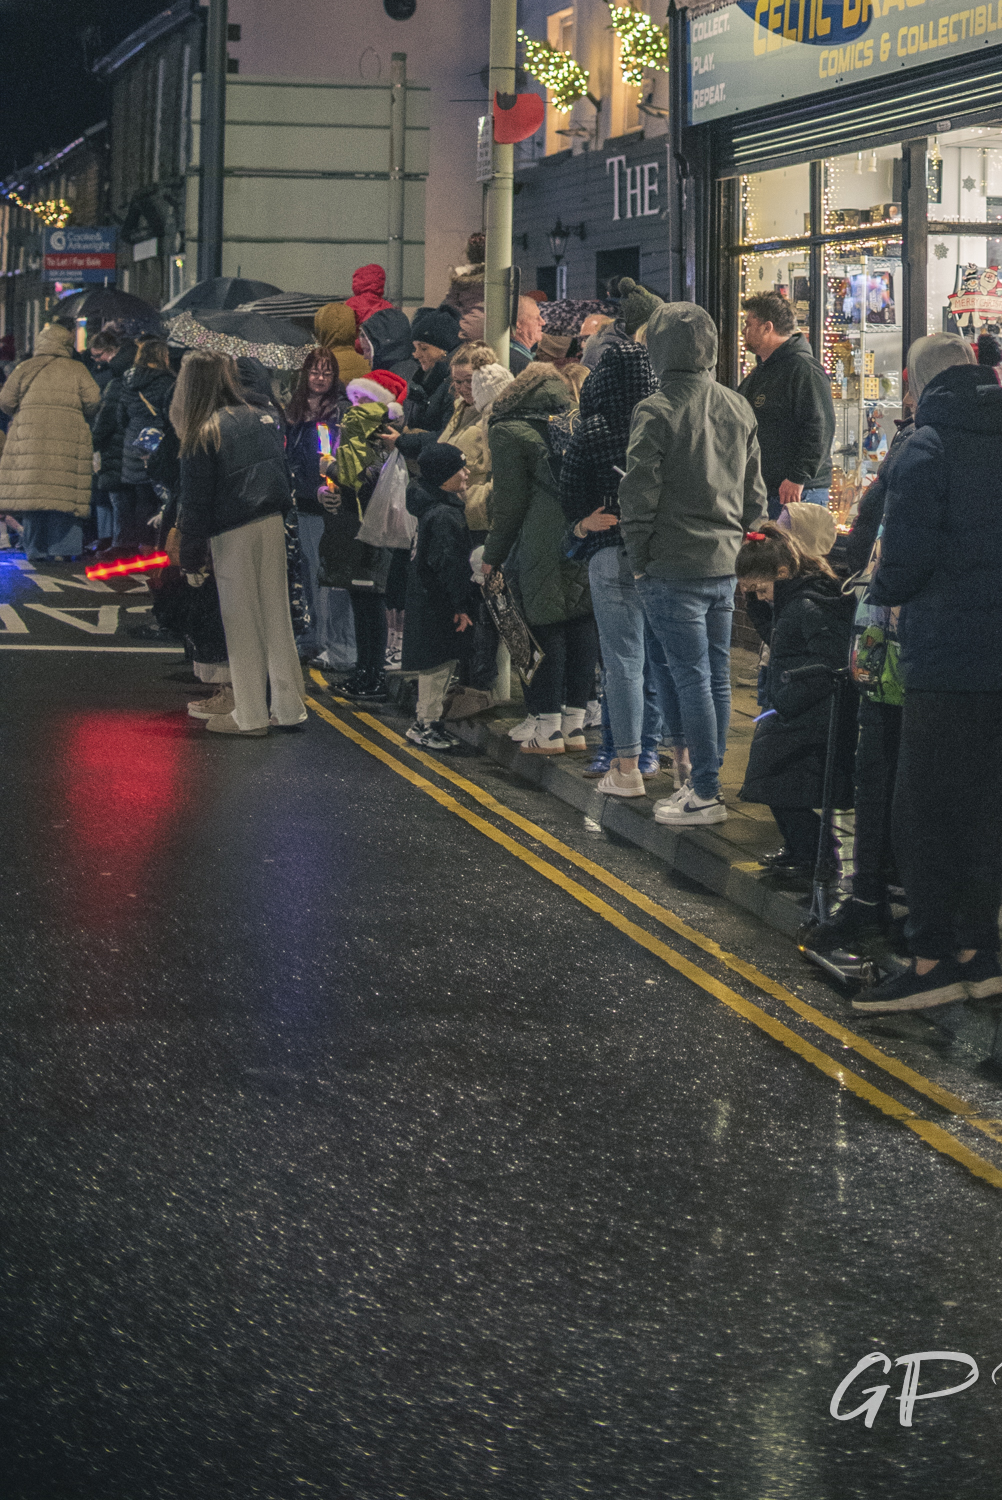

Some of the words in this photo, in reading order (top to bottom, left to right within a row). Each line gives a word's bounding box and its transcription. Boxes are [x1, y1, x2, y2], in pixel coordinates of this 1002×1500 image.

[692, 13, 731, 43] COLLECT.
[692, 52, 715, 77] PLAY.
[819, 40, 874, 79] COMICS
[879, 32, 891, 62] &
[692, 83, 726, 110] REPEAT.
[605, 154, 660, 221] THE
